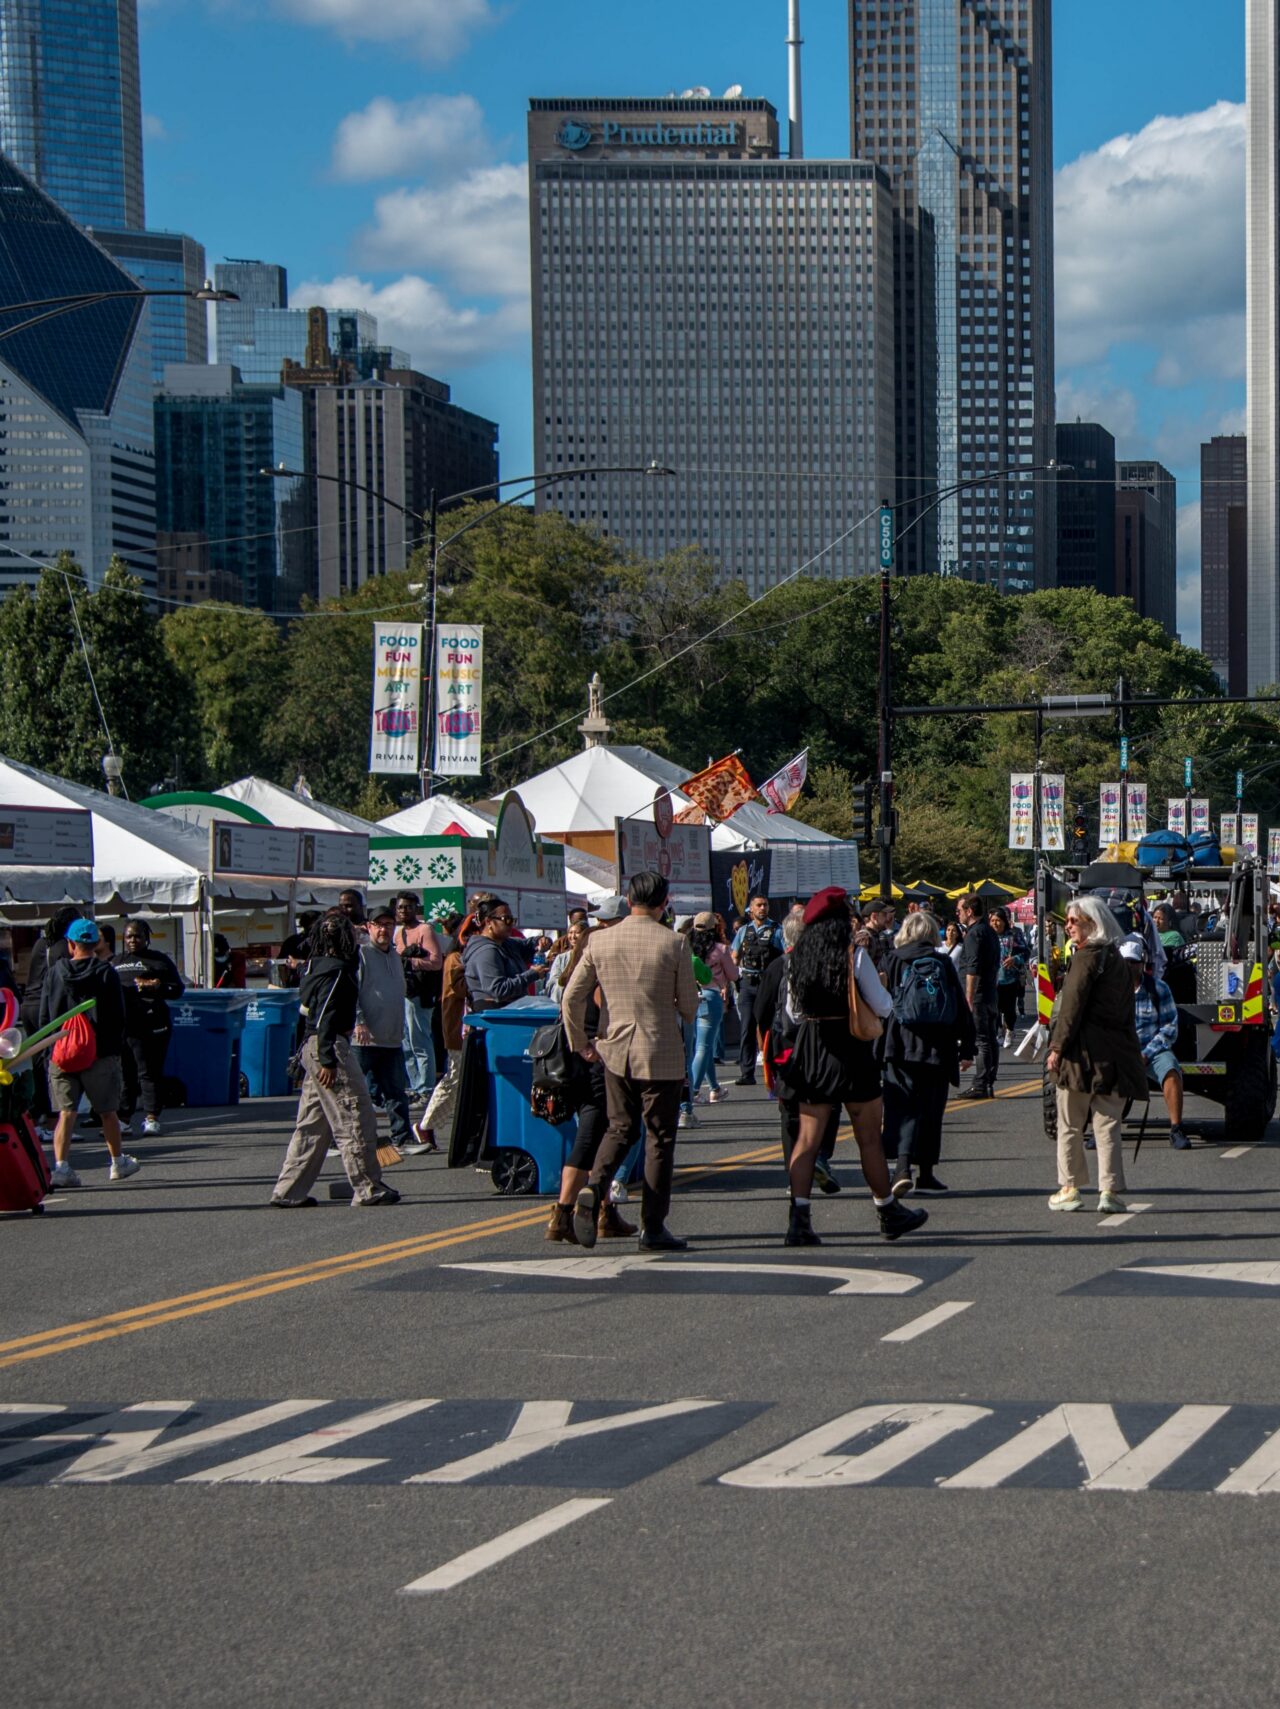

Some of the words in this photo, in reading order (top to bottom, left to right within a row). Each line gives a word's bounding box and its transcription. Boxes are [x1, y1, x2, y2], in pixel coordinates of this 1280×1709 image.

[603, 119, 736, 146] Prudential
[881, 516, 891, 559] C500
[380, 636, 417, 648] FOOD
[441, 638, 479, 649] FOOD
[386, 652, 411, 662] FUN
[448, 653, 473, 663] FUN
[377, 668, 418, 678] MUSIC
[440, 669, 480, 680] MUSIC
[384, 682, 410, 694] ART
[447, 684, 472, 695] ART
[375, 710, 411, 732] TASTE
[438, 712, 475, 733] TASTE
